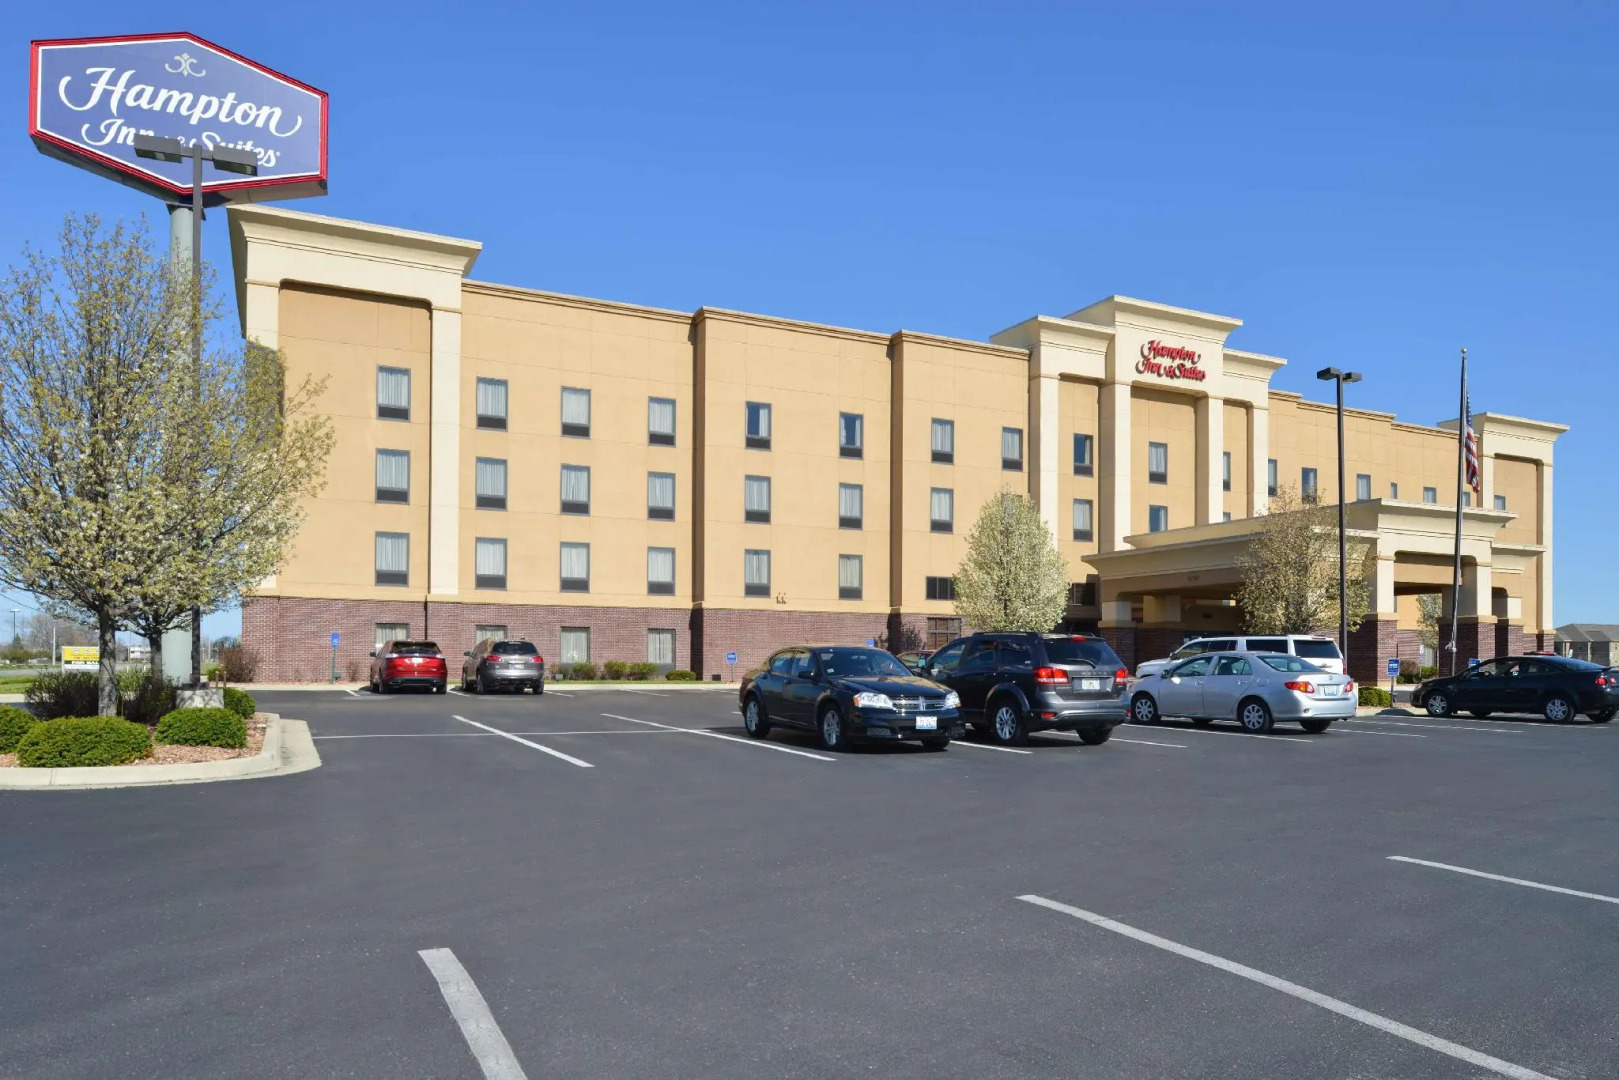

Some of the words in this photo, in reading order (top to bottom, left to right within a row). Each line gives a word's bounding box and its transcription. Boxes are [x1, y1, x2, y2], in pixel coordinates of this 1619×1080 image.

[58, 67, 302, 137] Hampton
[1140, 340, 1201, 365] Hampton
[1135, 358, 1164, 377] Inn
[1173, 363, 1206, 382] Suites
